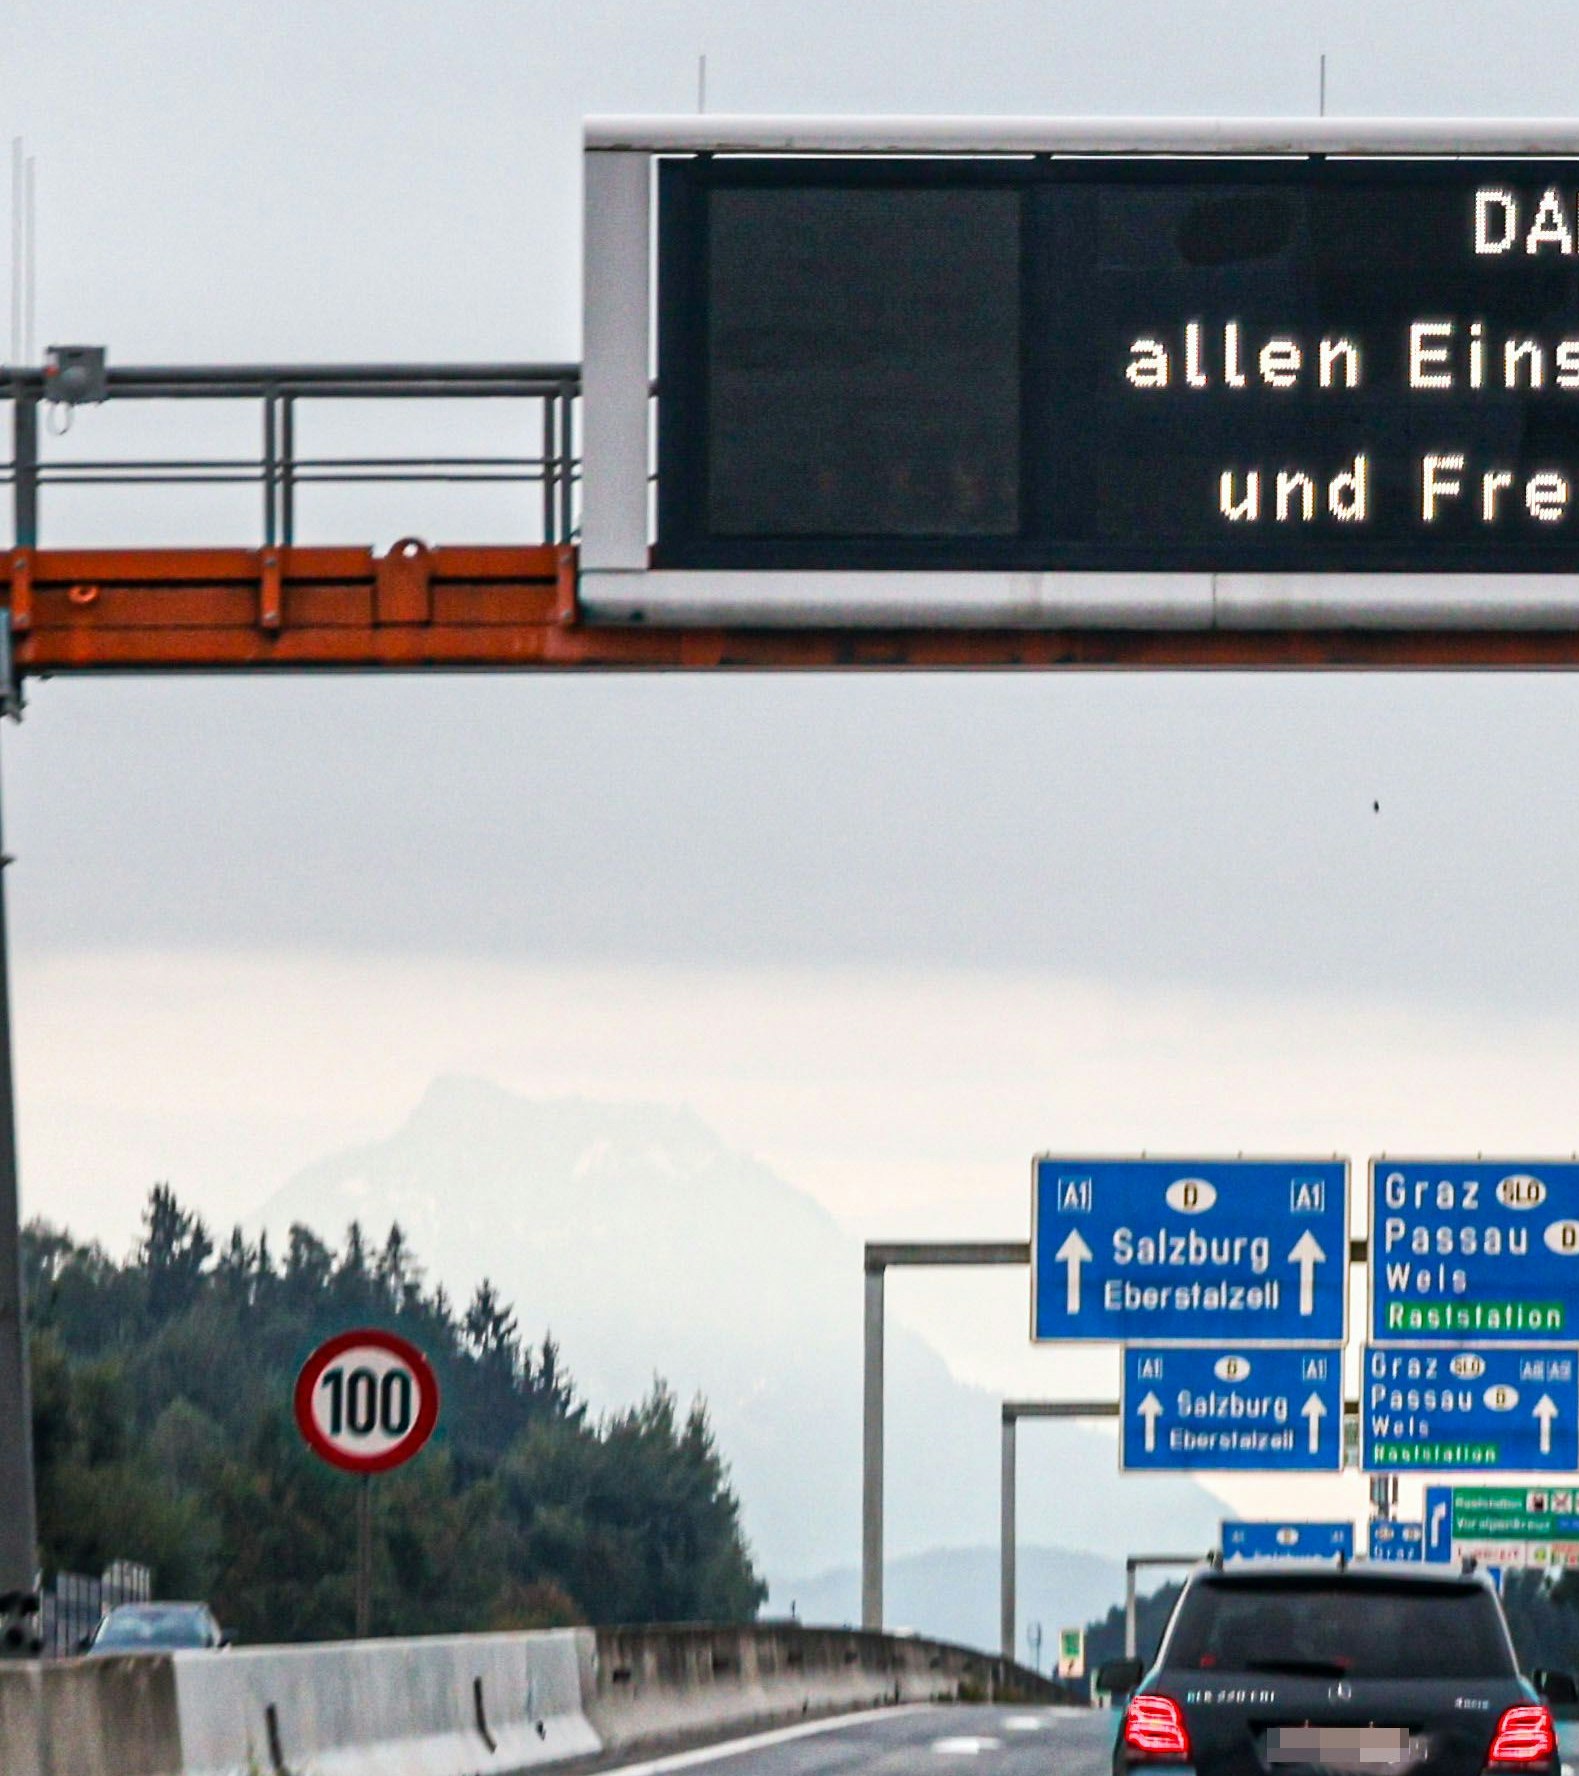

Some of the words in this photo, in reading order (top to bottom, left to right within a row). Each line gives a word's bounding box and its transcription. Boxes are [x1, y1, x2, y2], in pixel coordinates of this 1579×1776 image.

[1124, 320, 1360, 388] allen
[1217, 452, 1367, 522] und
[1063, 1181, 1089, 1207] A1
[1296, 1181, 1321, 1208] A1
[1385, 1172, 1480, 1210] Graz
[1502, 1178, 1540, 1205] SLO
[1112, 1226, 1270, 1275] Salzburg
[1385, 1217, 1528, 1256] Passau
[1386, 1261, 1467, 1295] Wels
[1104, 1279, 1280, 1312] Eberstalzell
[1388, 1301, 1562, 1330] Raststation
[1371, 1350, 1438, 1380] Graz
[322, 1365, 413, 1438] 100
[1177, 1389, 1289, 1425] Salzburg
[1371, 1382, 1473, 1412] Passau
[1169, 1427, 1295, 1451] Eberstalzell
[1372, 1414, 1429, 1439] Wels
